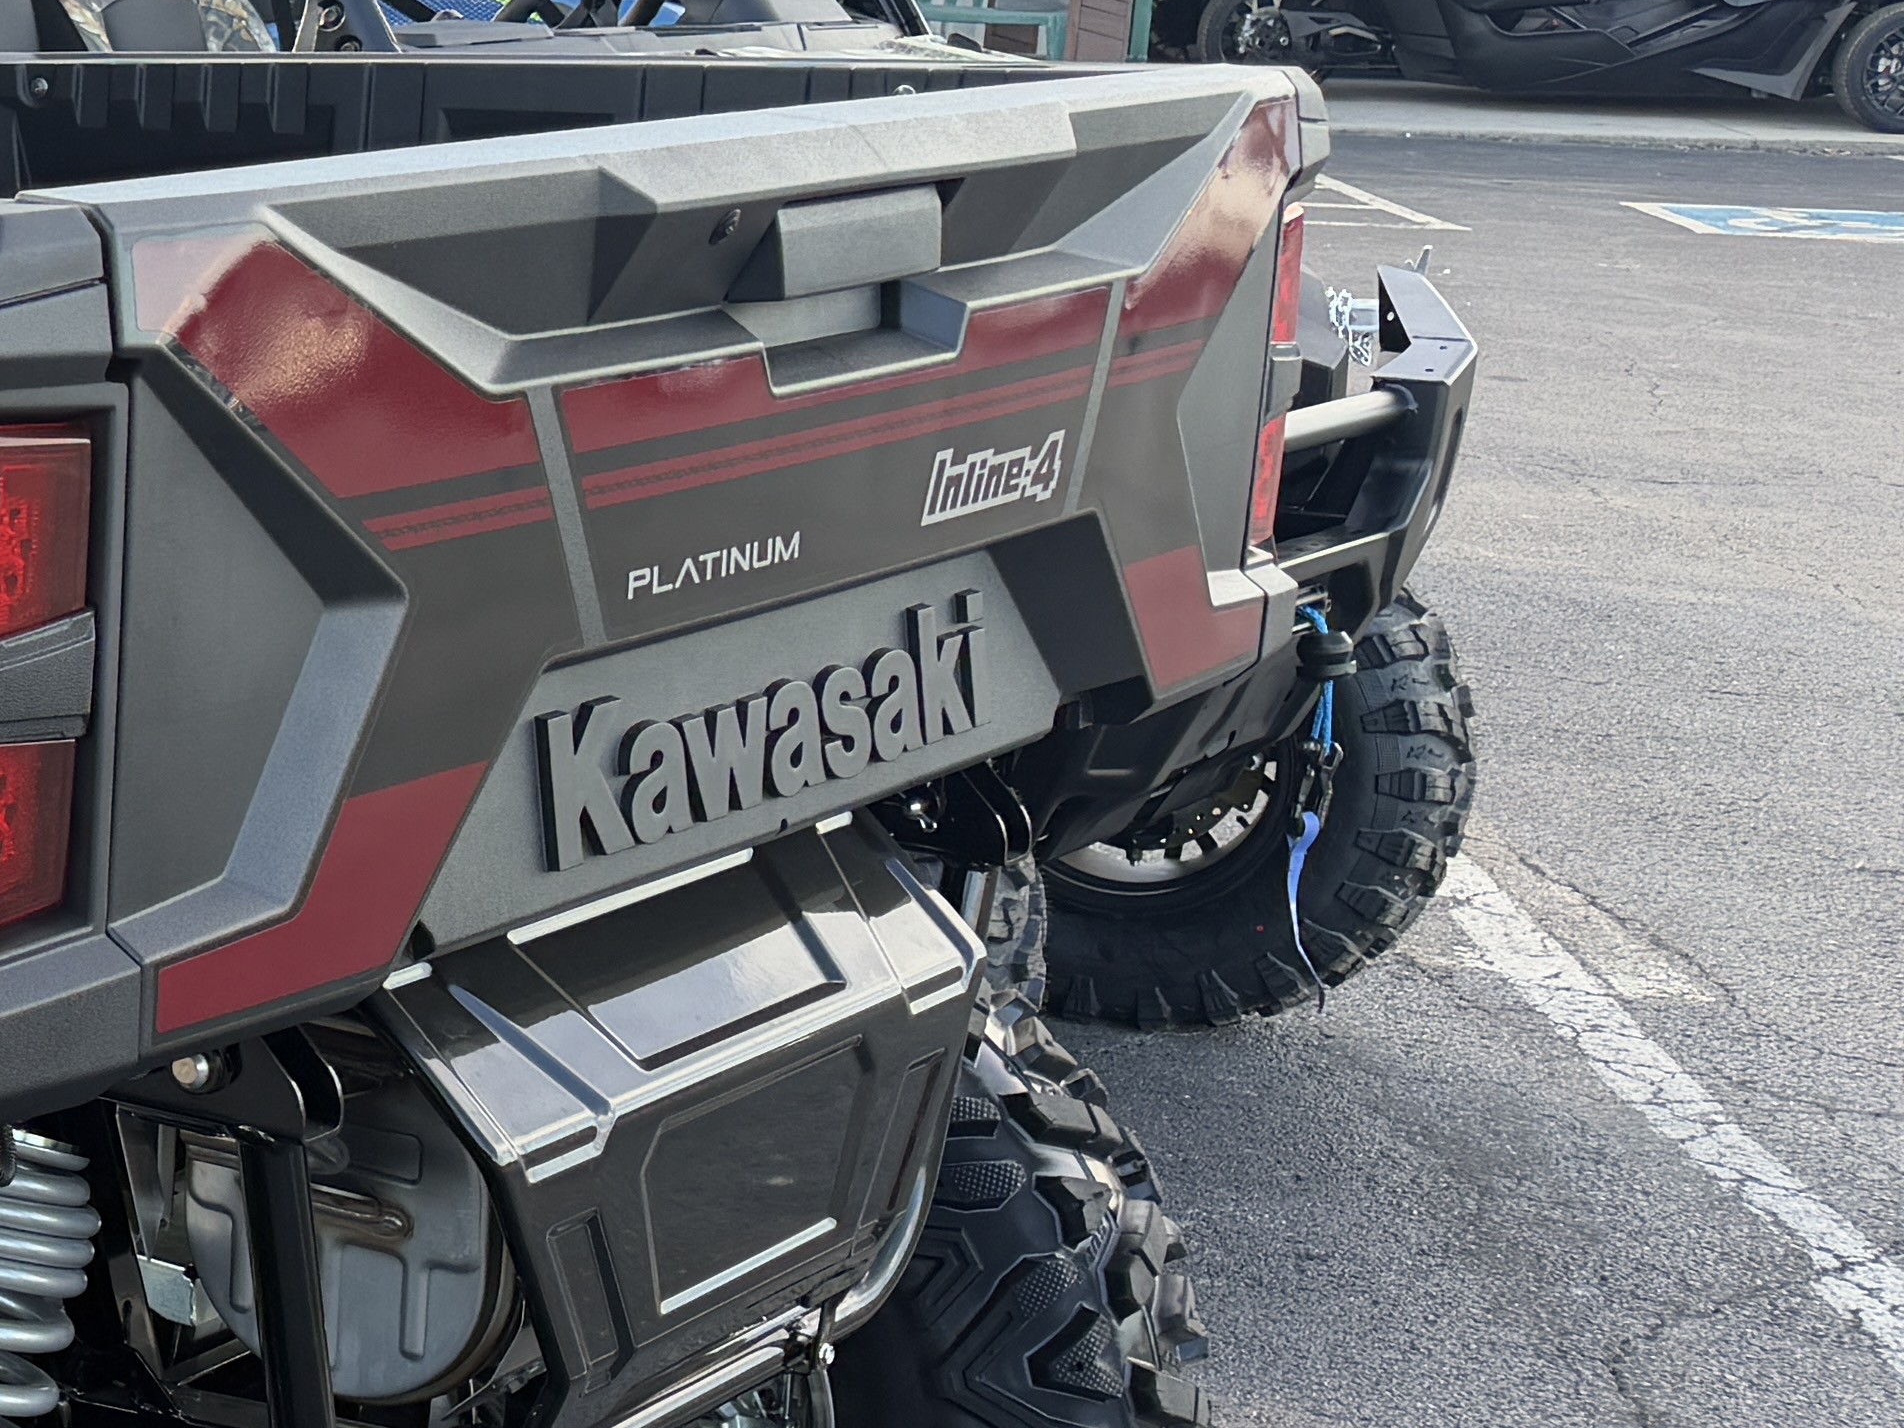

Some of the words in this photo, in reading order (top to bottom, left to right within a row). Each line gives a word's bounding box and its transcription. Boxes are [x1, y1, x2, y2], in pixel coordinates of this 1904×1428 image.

[921, 430, 1065, 526] Inline-4
[627, 532, 801, 600] PLATINUM
[535, 590, 991, 871] Kawasaki
